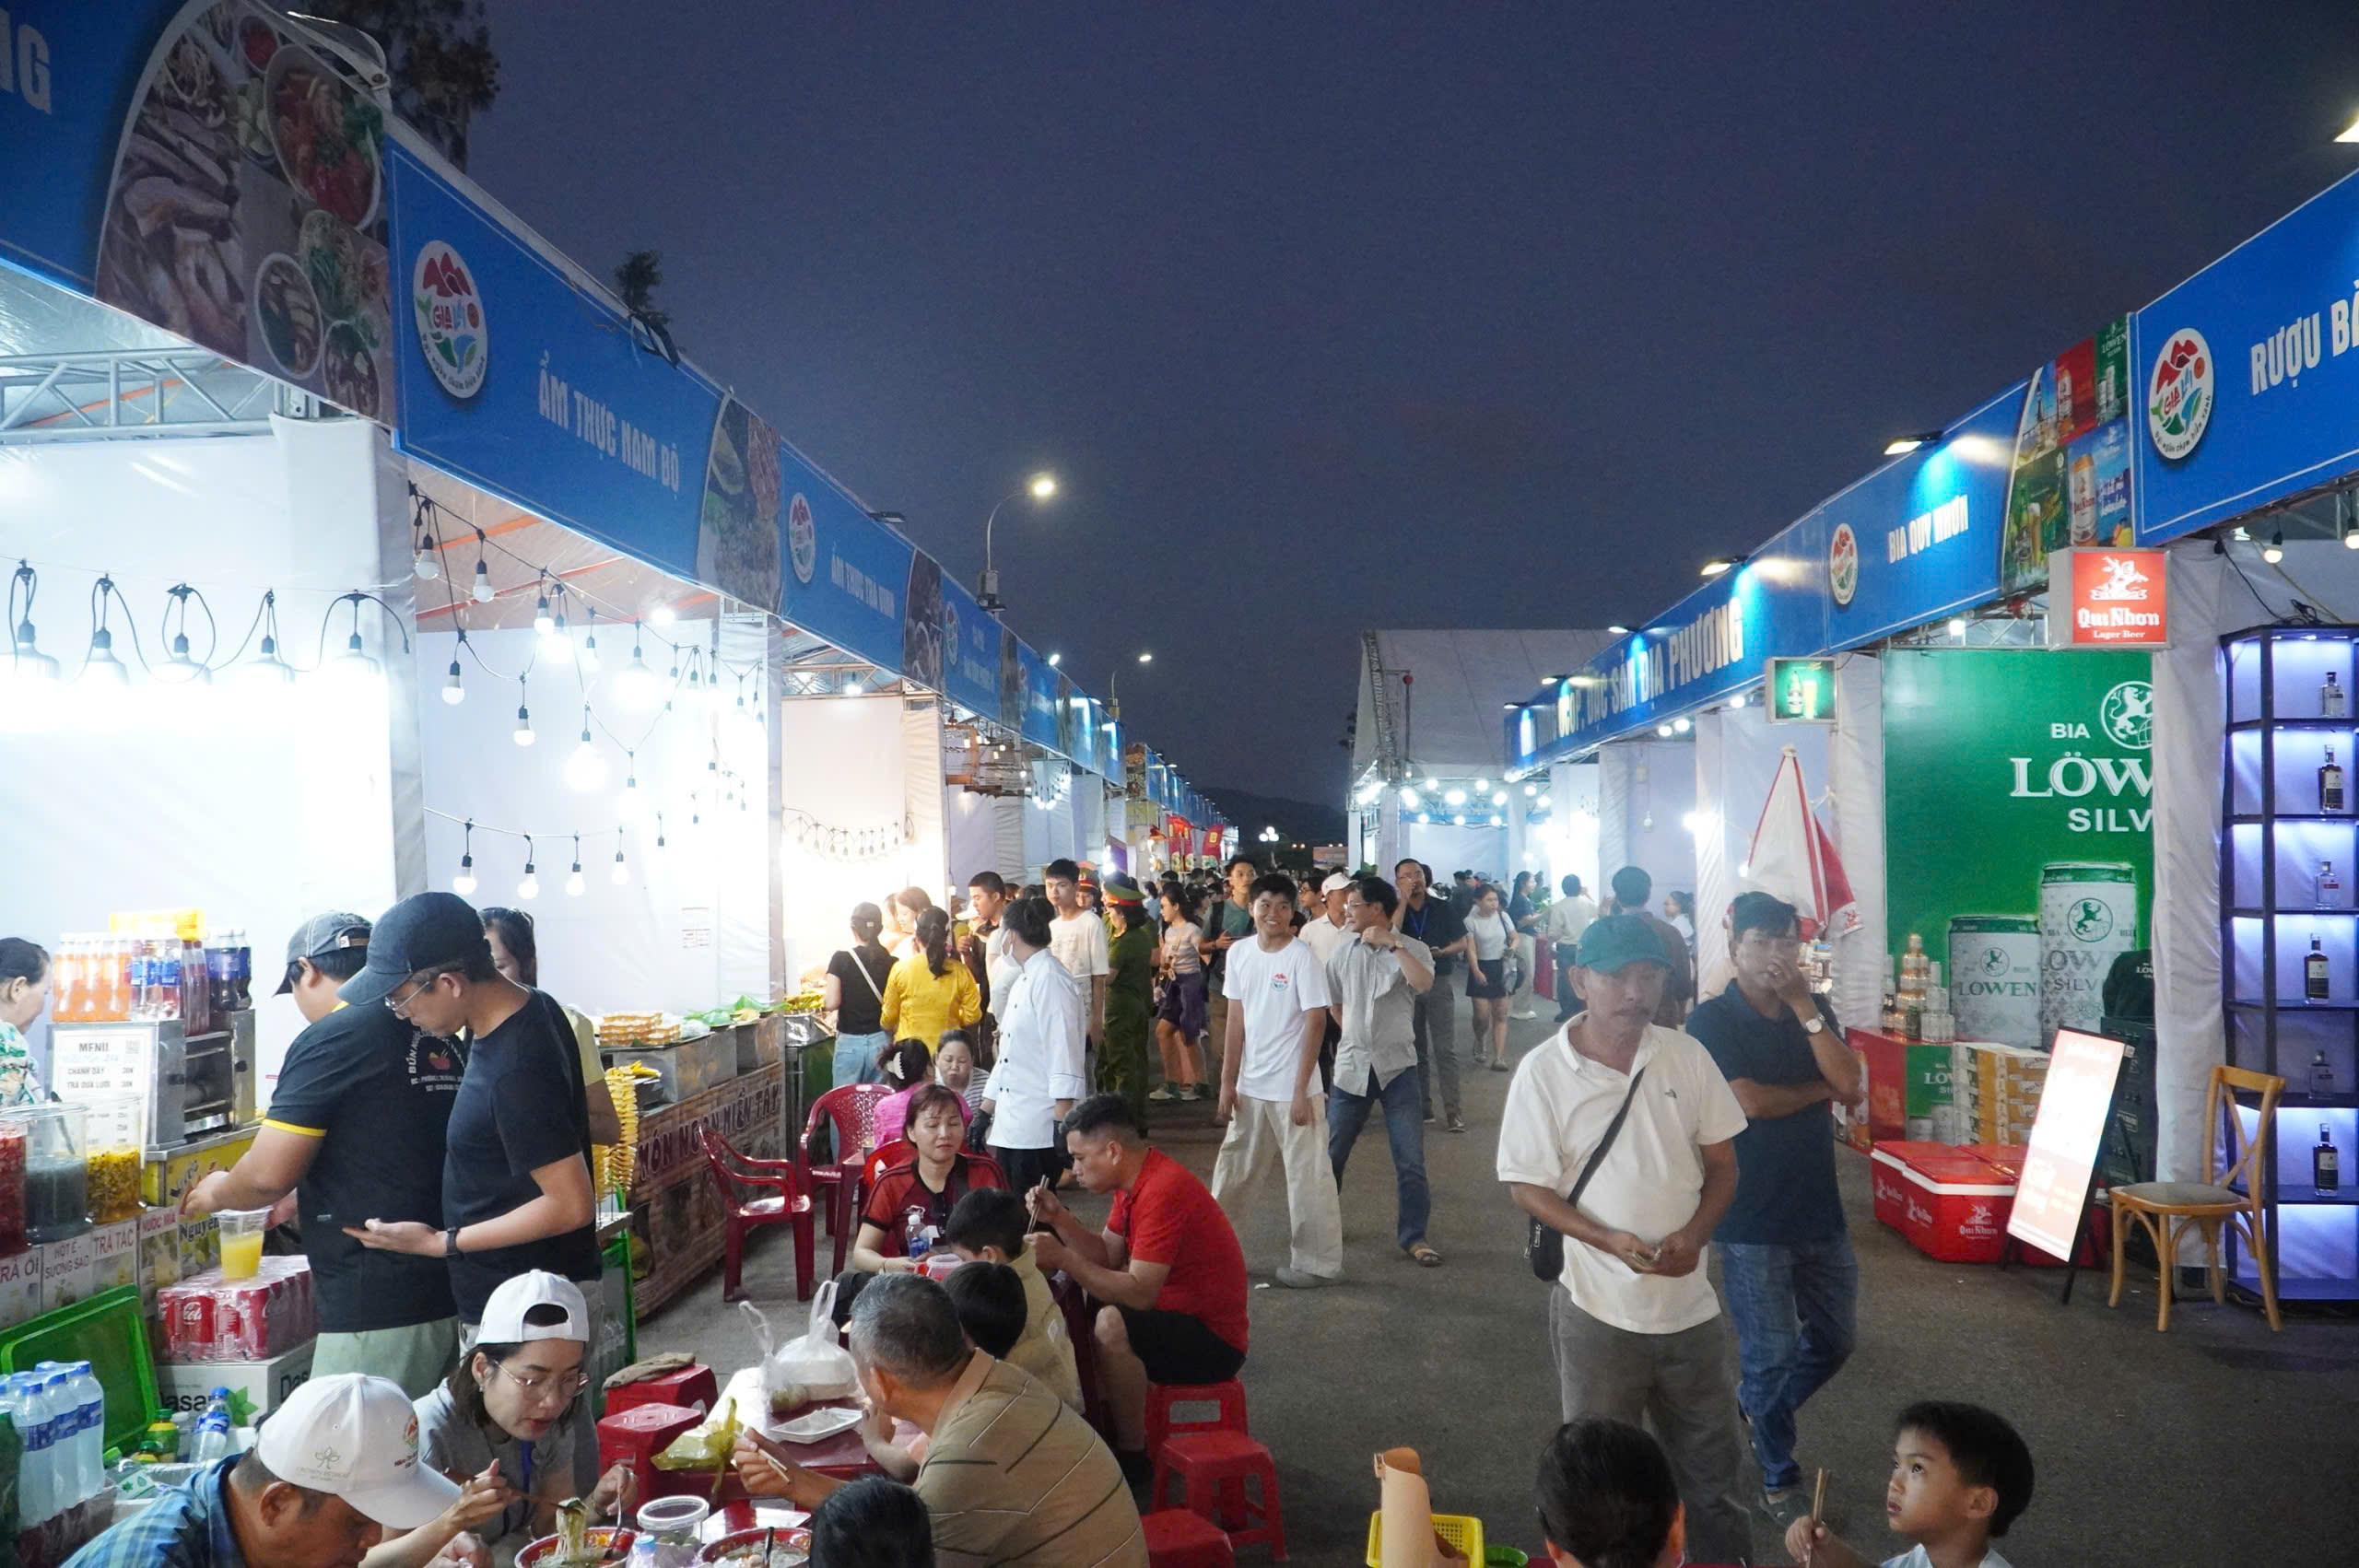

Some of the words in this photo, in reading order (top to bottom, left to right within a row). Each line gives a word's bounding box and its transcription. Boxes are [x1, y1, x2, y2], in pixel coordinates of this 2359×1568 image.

[2250, 311, 2321, 396] RƯỢU
[538, 349, 569, 430] ẨM
[573, 390, 616, 461] THỰC
[621, 419, 656, 479] NAM
[661, 443, 679, 500] BỘ
[1888, 526, 1907, 564] BIA
[1908, 511, 1931, 555] QUY
[1669, 595, 1743, 690] PHƯƠNG
[2094, 630, 2120, 640] Lager
[2122, 629, 2146, 638] Beer
[2051, 722, 2091, 739] BIA
[2068, 808, 2154, 832] SILV
